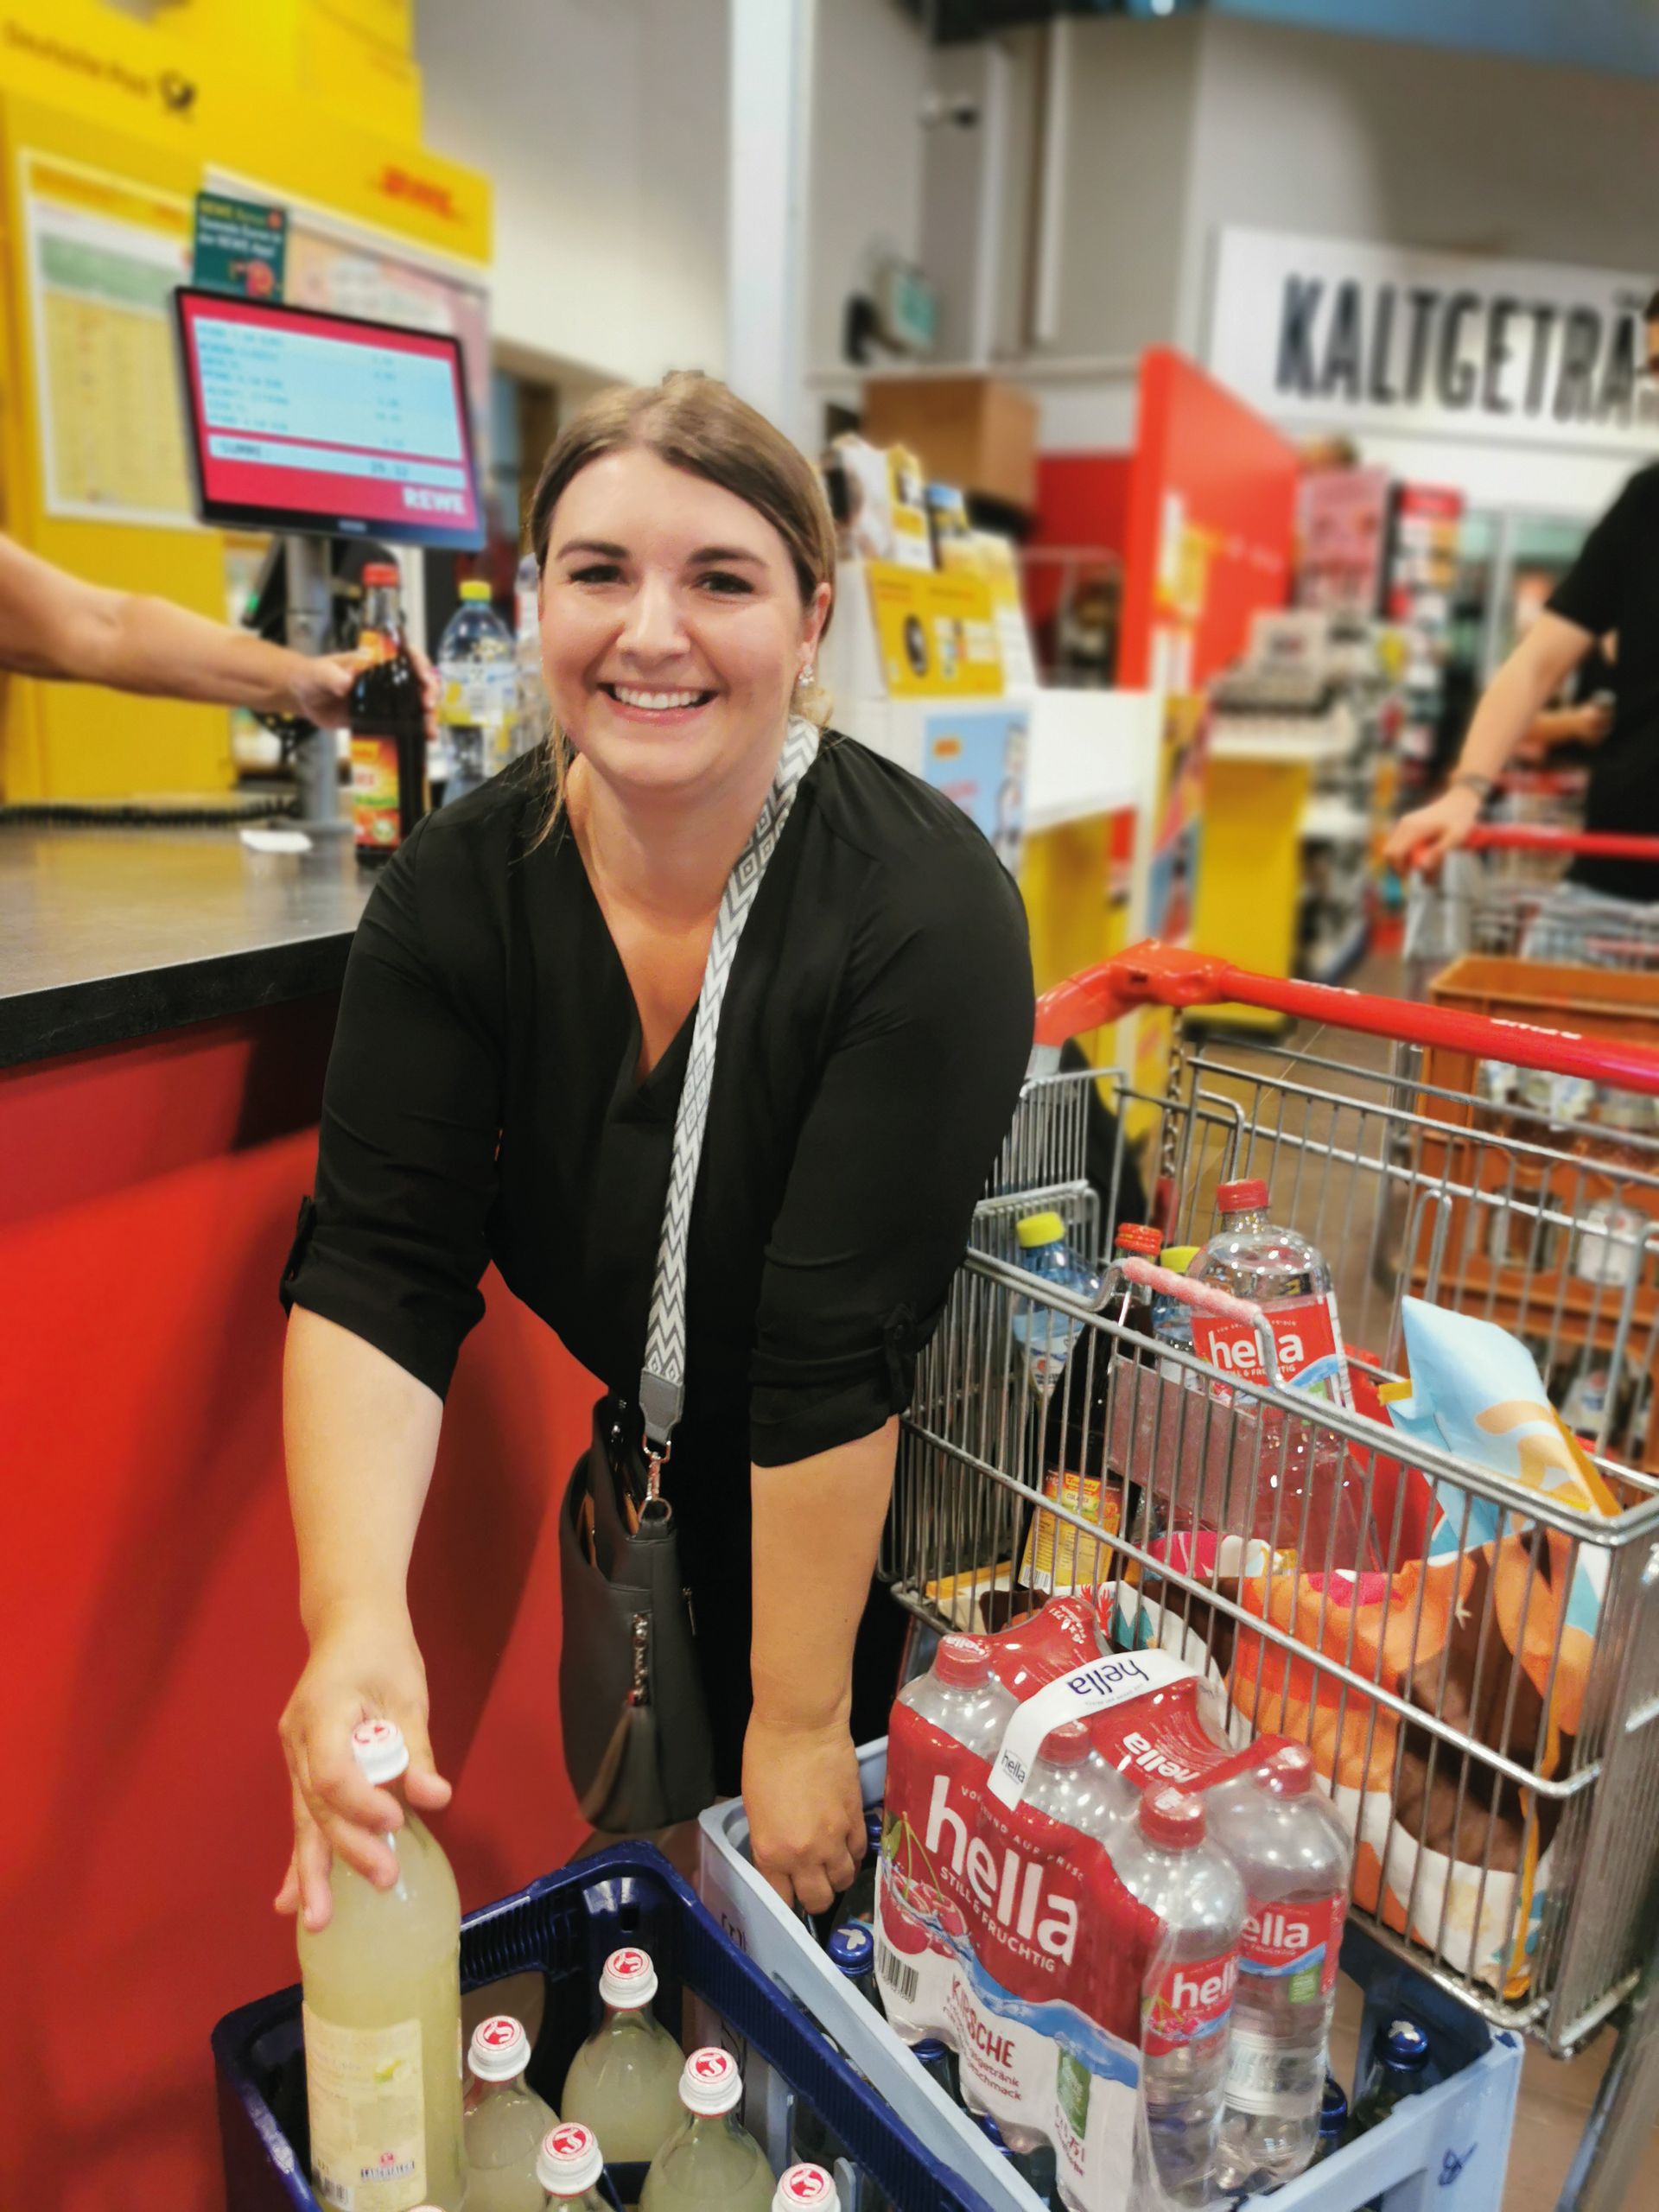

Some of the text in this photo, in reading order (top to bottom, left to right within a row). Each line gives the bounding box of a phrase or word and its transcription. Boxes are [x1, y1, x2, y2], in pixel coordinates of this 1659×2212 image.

[403, 485, 467, 516] REWE
[1208, 1328, 1305, 1370] hela
[1067, 1659, 1149, 1695] hella
[1001, 1748, 1027, 1784] hella
[925, 1774, 1078, 1967] hella
[939, 1865, 971, 1904] STILL
[981, 1910, 1056, 1974] FRUCHTIG
